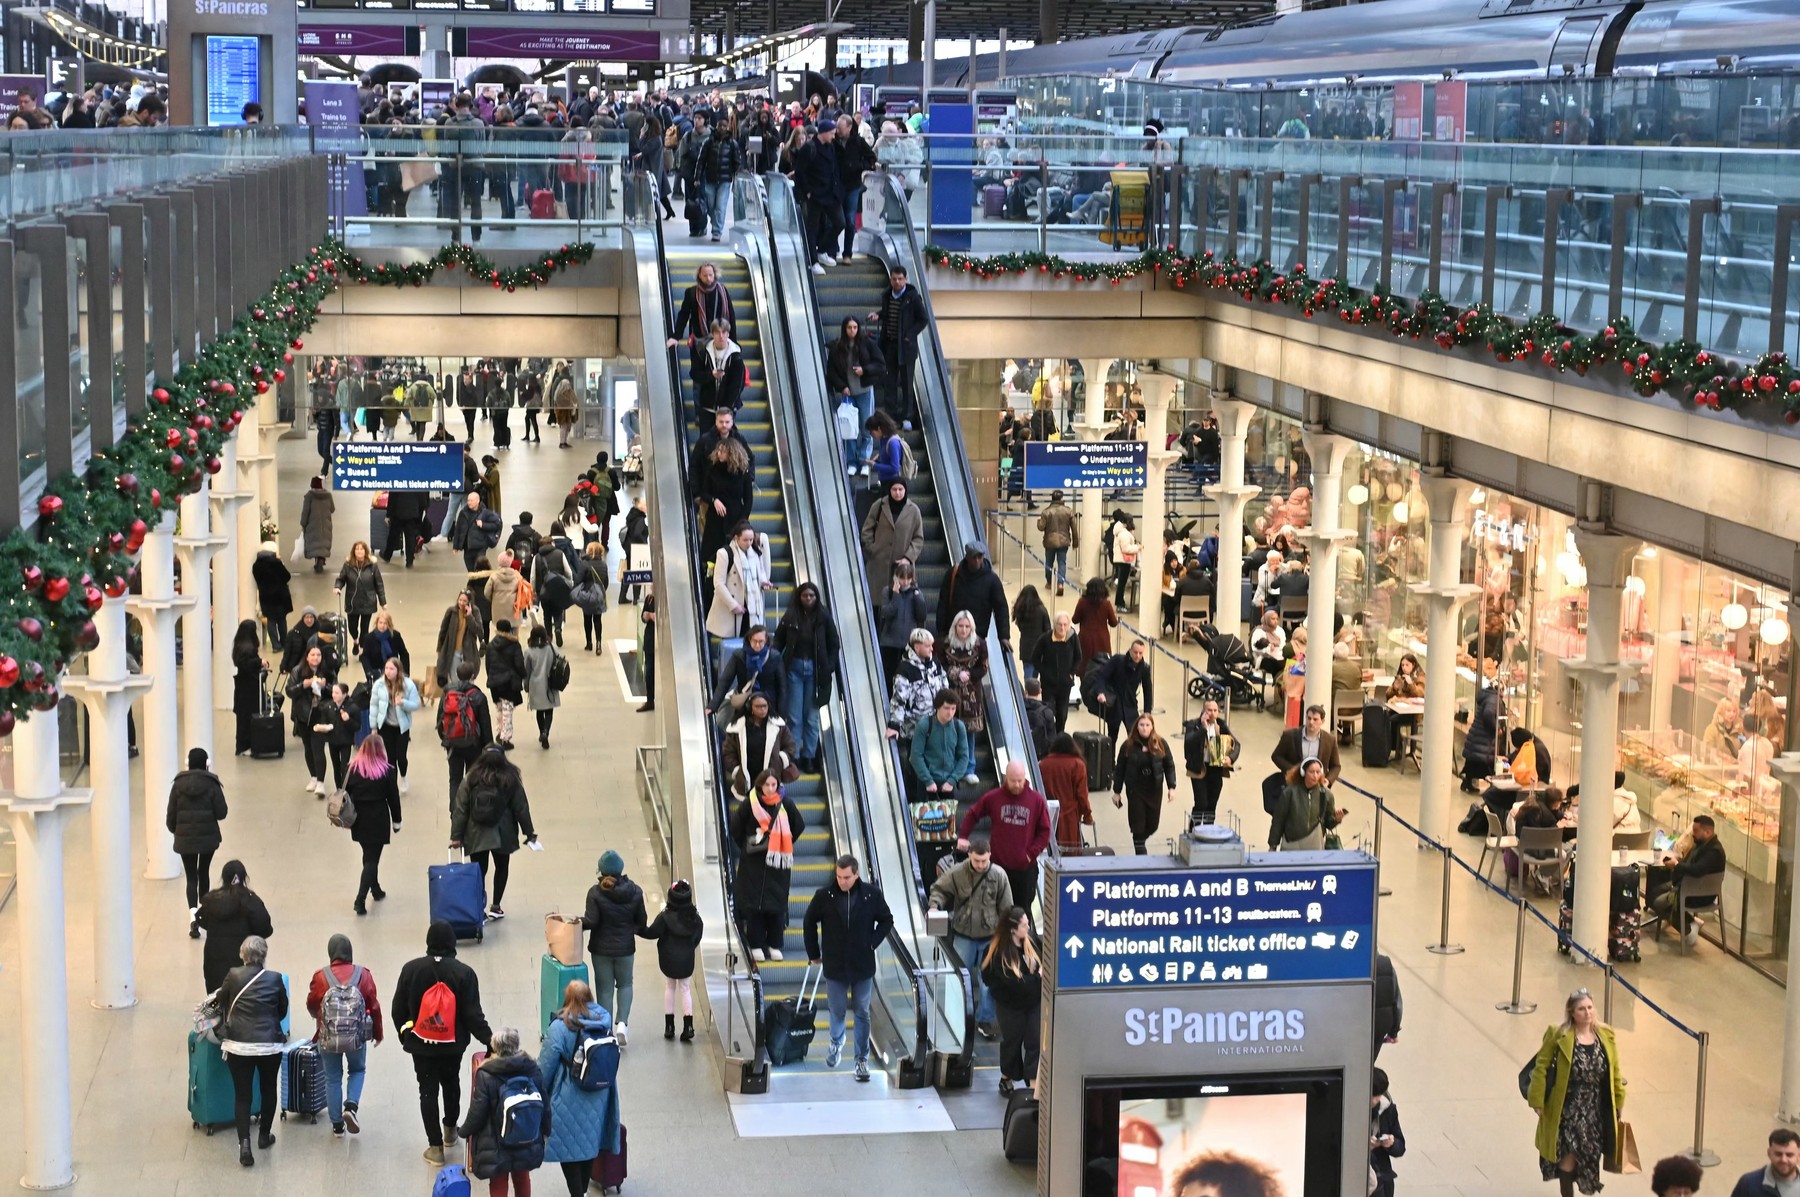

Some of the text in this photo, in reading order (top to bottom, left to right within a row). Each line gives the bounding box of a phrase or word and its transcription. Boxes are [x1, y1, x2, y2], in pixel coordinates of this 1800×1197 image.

[347, 445, 382, 453] Platforms
[390, 445, 403, 453] and
[405, 445, 410, 453] B
[1081, 444, 1113, 452] Platforms
[347, 455, 363, 466] Way
[364, 456, 376, 465] out
[1090, 456, 1133, 464] Underground
[348, 468, 369, 476] Buses
[1107, 466, 1121, 476] Way
[1122, 466, 1133, 475] out
[363, 480, 449, 488] National Rail ticket office
[1094, 881, 1179, 899] Platforms
[1183, 880, 1196, 897] A
[1200, 879, 1231, 896] and
[1237, 878, 1248, 895] B
[1093, 909, 1178, 926] Platforms
[1185, 907, 1231, 924] 11-13
[1093, 933, 1306, 954] National Rail ticket office
[420, 1024, 448, 1032] adidas
[1216, 1045, 1304, 1056] INTERNATIONAL
